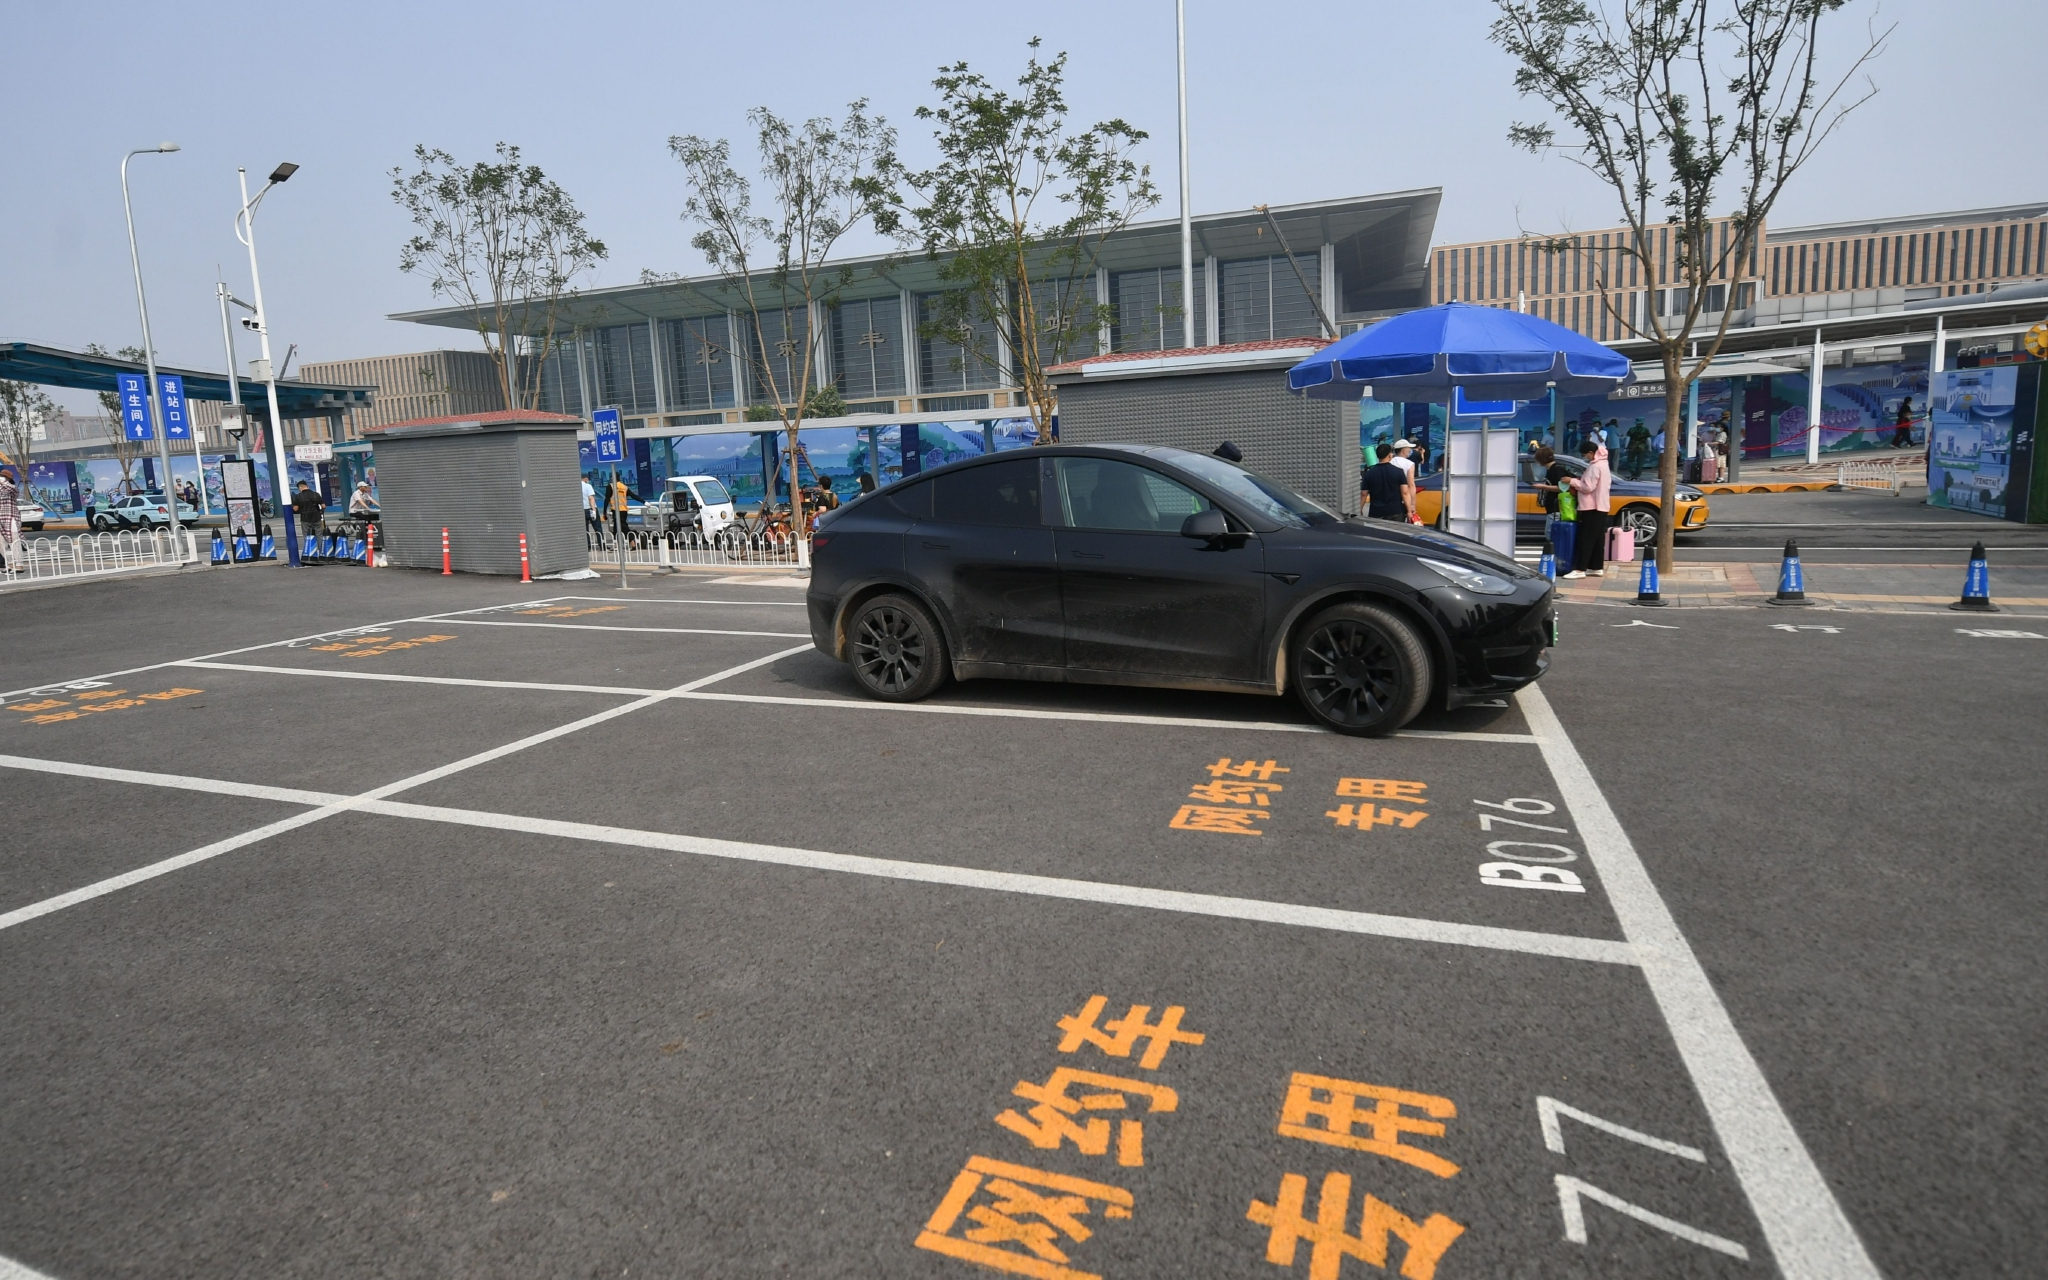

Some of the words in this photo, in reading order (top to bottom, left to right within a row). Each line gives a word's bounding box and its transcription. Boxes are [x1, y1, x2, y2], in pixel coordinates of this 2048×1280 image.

[126, 379, 144, 421] 卫生间
[164, 380, 181, 421] 进站口
[595, 419, 618, 436] 网约车
[601, 439, 617, 455] 区域
[1168, 757, 1291, 836] 网约车
[1324, 776, 1430, 832] 专用
[1473, 796, 1587, 893] B076
[914, 994, 1206, 1280] 网约车
[1245, 1071, 1466, 1280] 专用
